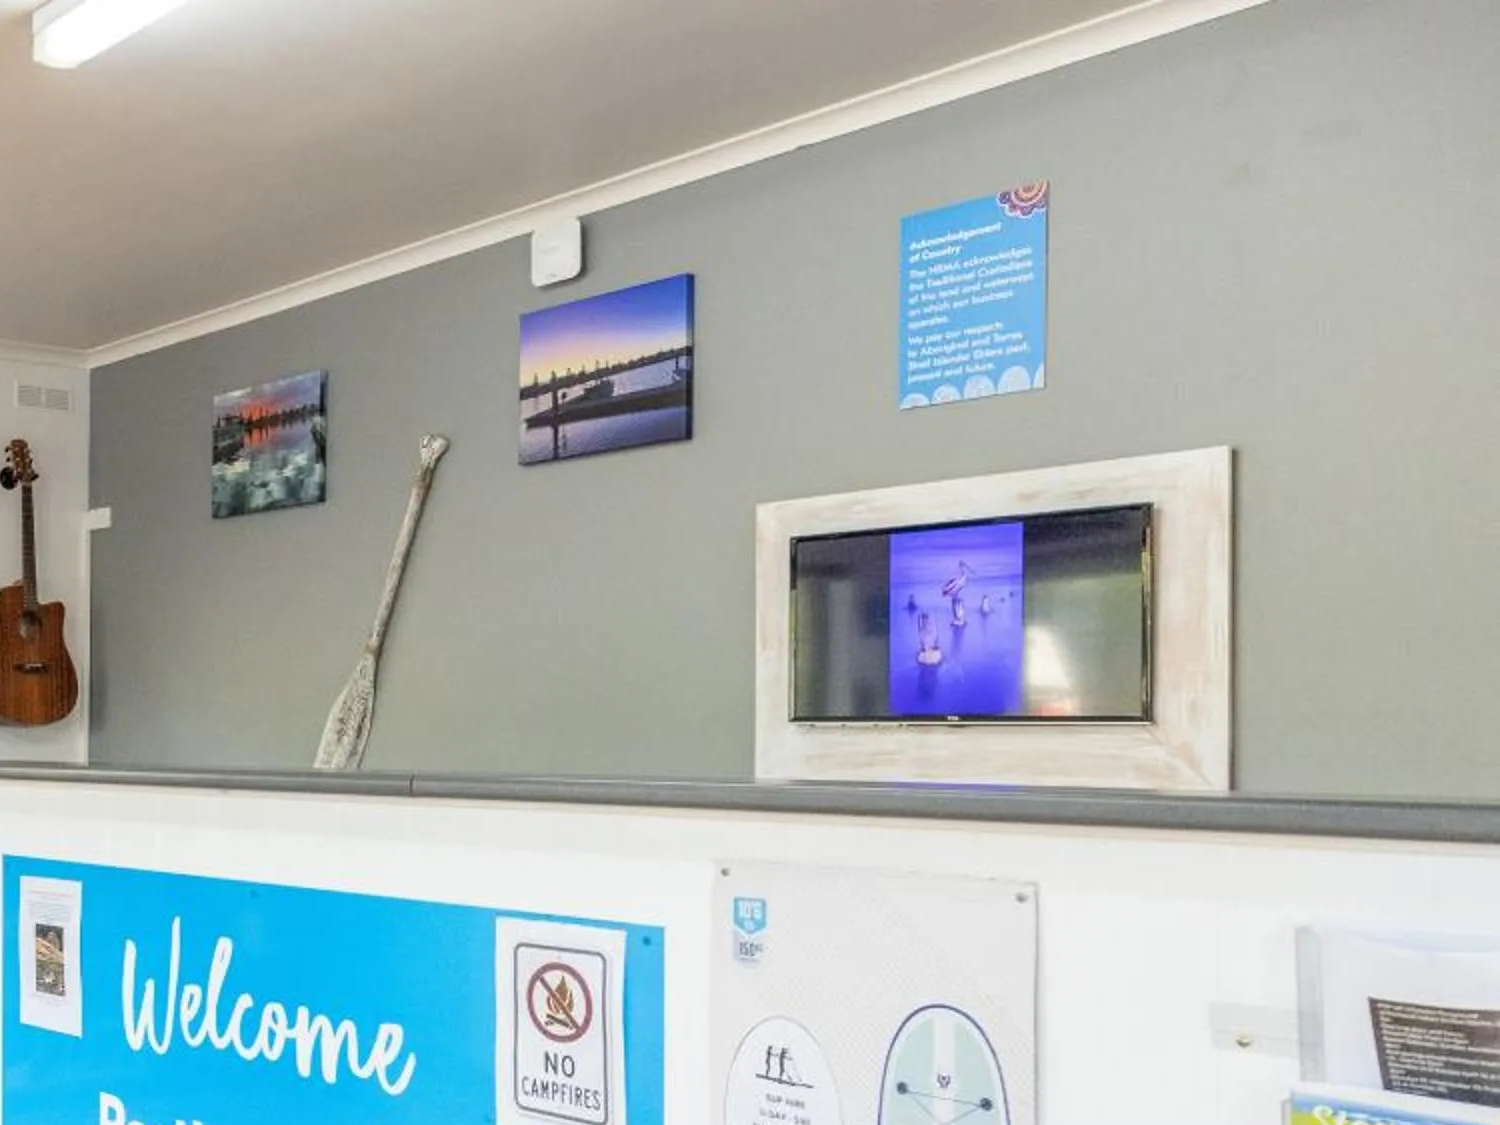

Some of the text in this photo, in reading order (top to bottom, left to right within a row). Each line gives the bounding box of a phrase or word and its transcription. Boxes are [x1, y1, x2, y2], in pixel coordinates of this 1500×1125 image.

[122, 916, 417, 1096] Welcome
[544, 1051, 575, 1078] NO
[521, 1076, 601, 1111] CAMPFIRES
